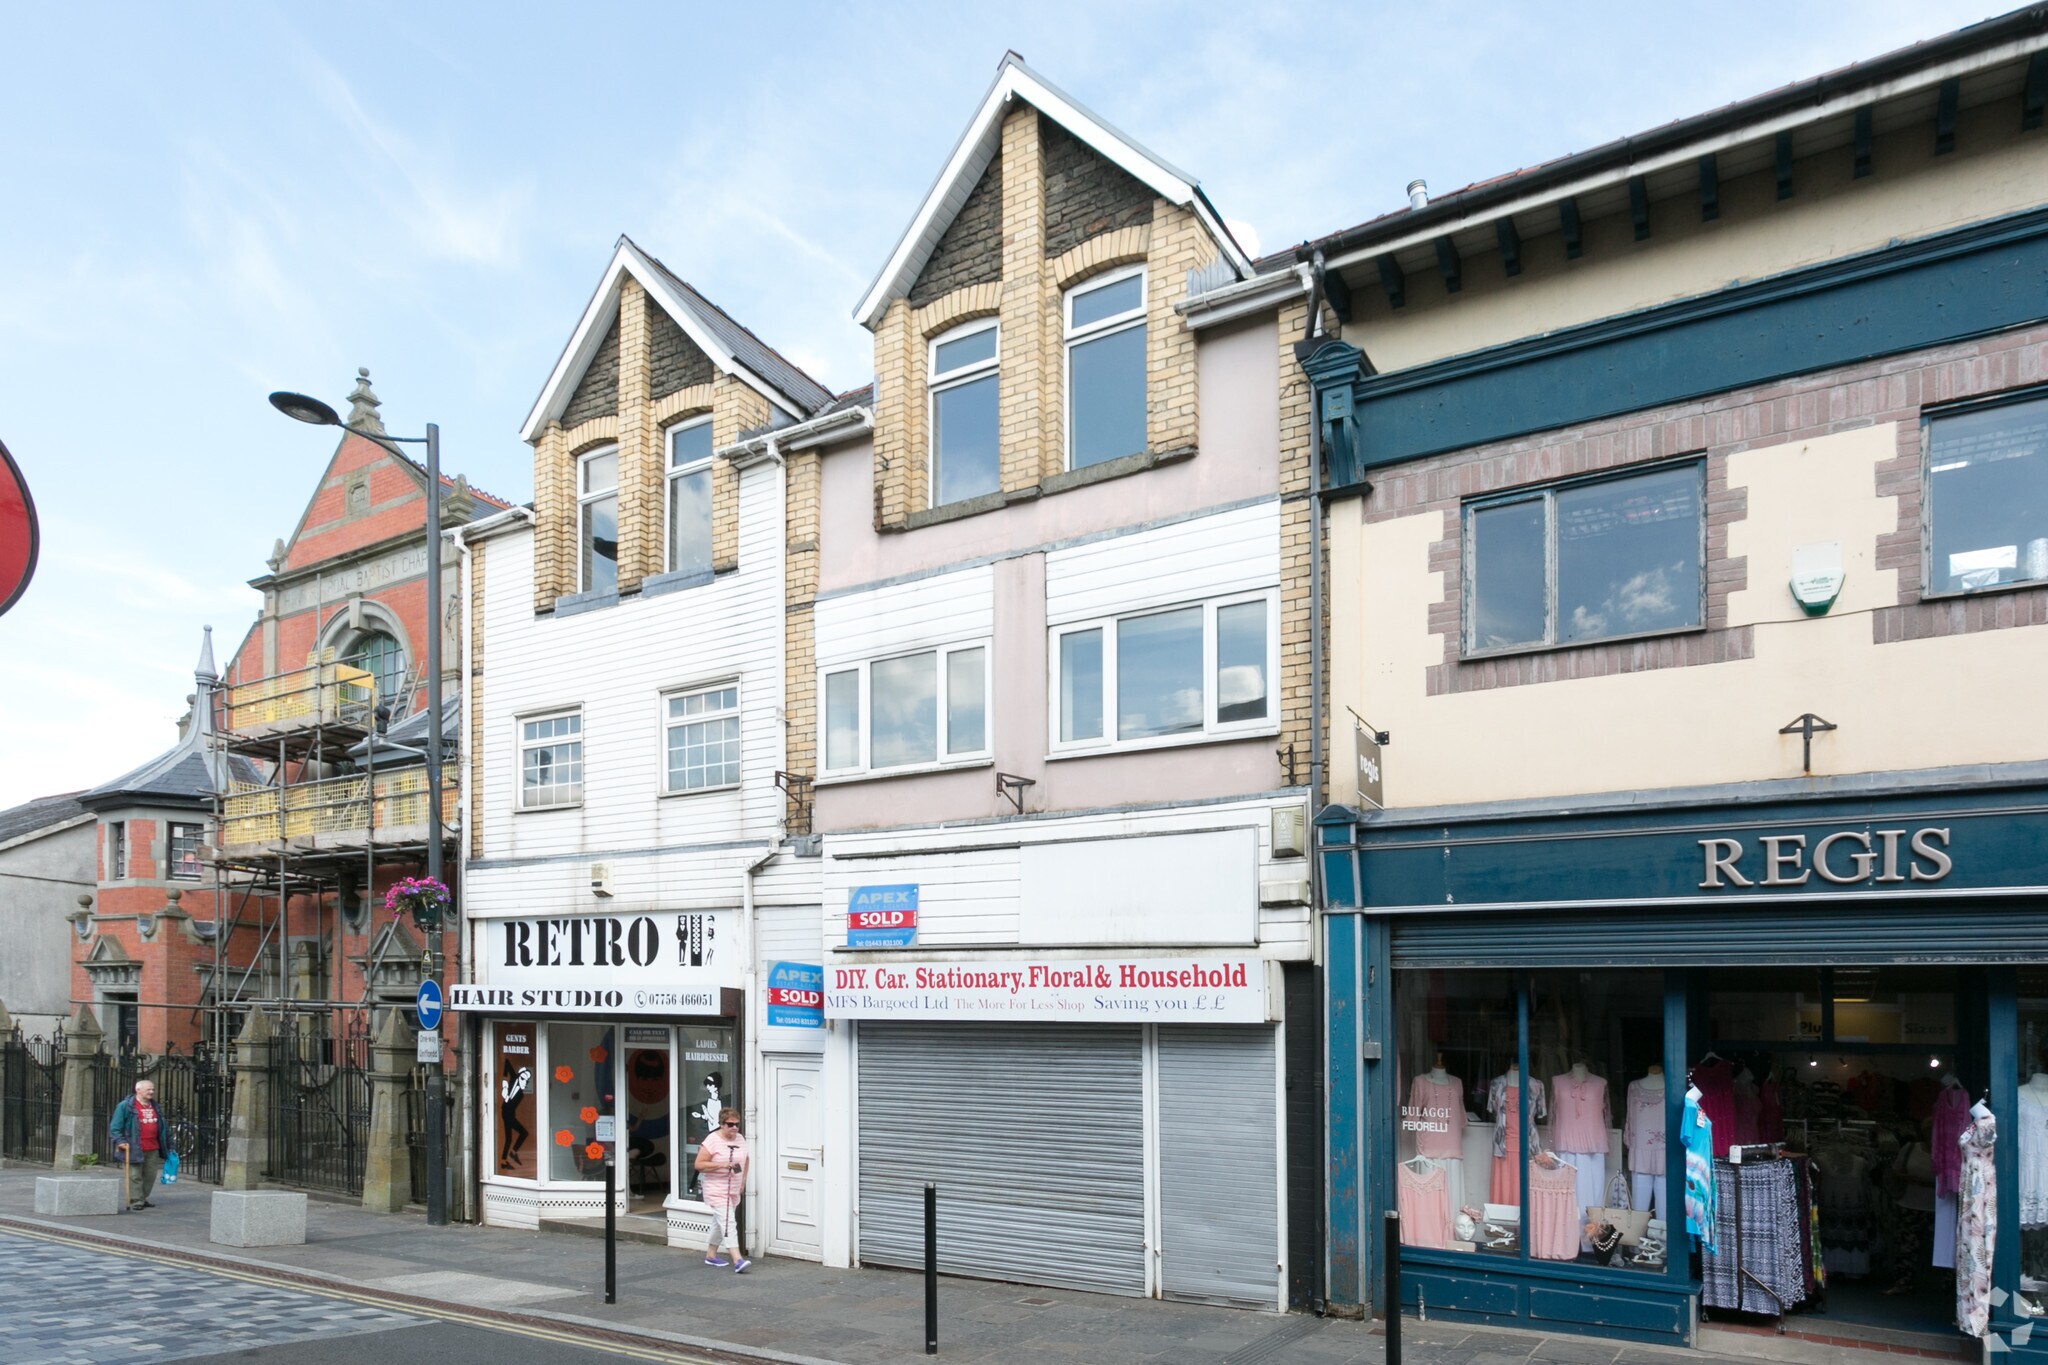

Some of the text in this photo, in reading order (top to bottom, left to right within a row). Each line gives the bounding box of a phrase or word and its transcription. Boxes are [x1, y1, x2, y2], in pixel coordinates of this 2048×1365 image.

[357, 559, 398, 587] BAPTIST
[402, 550, 428, 574] CHAP
[1360, 754, 1379, 784] regis
[1698, 828, 1953, 888] REGIS
[857, 891, 909, 904] APEX
[859, 911, 904, 926] SOLD
[504, 916, 659, 967] RETRO
[775, 968, 822, 983] APEX
[836, 969, 869, 989] DIY.
[875, 968, 909, 989] Car.
[1119, 962, 1248, 988] Household
[453, 989, 623, 1007] HAIR STUDIO
[649, 993, 713, 1006] 07756 466051
[779, 989, 820, 1004] SOLD
[826, 995, 858, 1009] MFS
[863, 995, 919, 1011] Bargoed
[924, 995, 949, 1009] Ltd
[954, 998, 975, 1009] The
[978, 999, 1006, 1009] More
[1009, 998, 1027, 1009] For
[1031, 999, 1054, 1009] Less
[1057, 998, 1085, 1013] Shop
[1093, 994, 1149, 1013] Saving
[1154, 1000, 1187, 1013] you
[1801, 1022, 1822, 1033] Plu
[505, 1034, 527, 1043] GENTS
[696, 1040, 717, 1048] LADIES
[503, 1045, 530, 1055] BARBER
[685, 1051, 728, 1062] HAIRDRESSER
[1402, 1120, 1448, 1133] FEIORELLI
